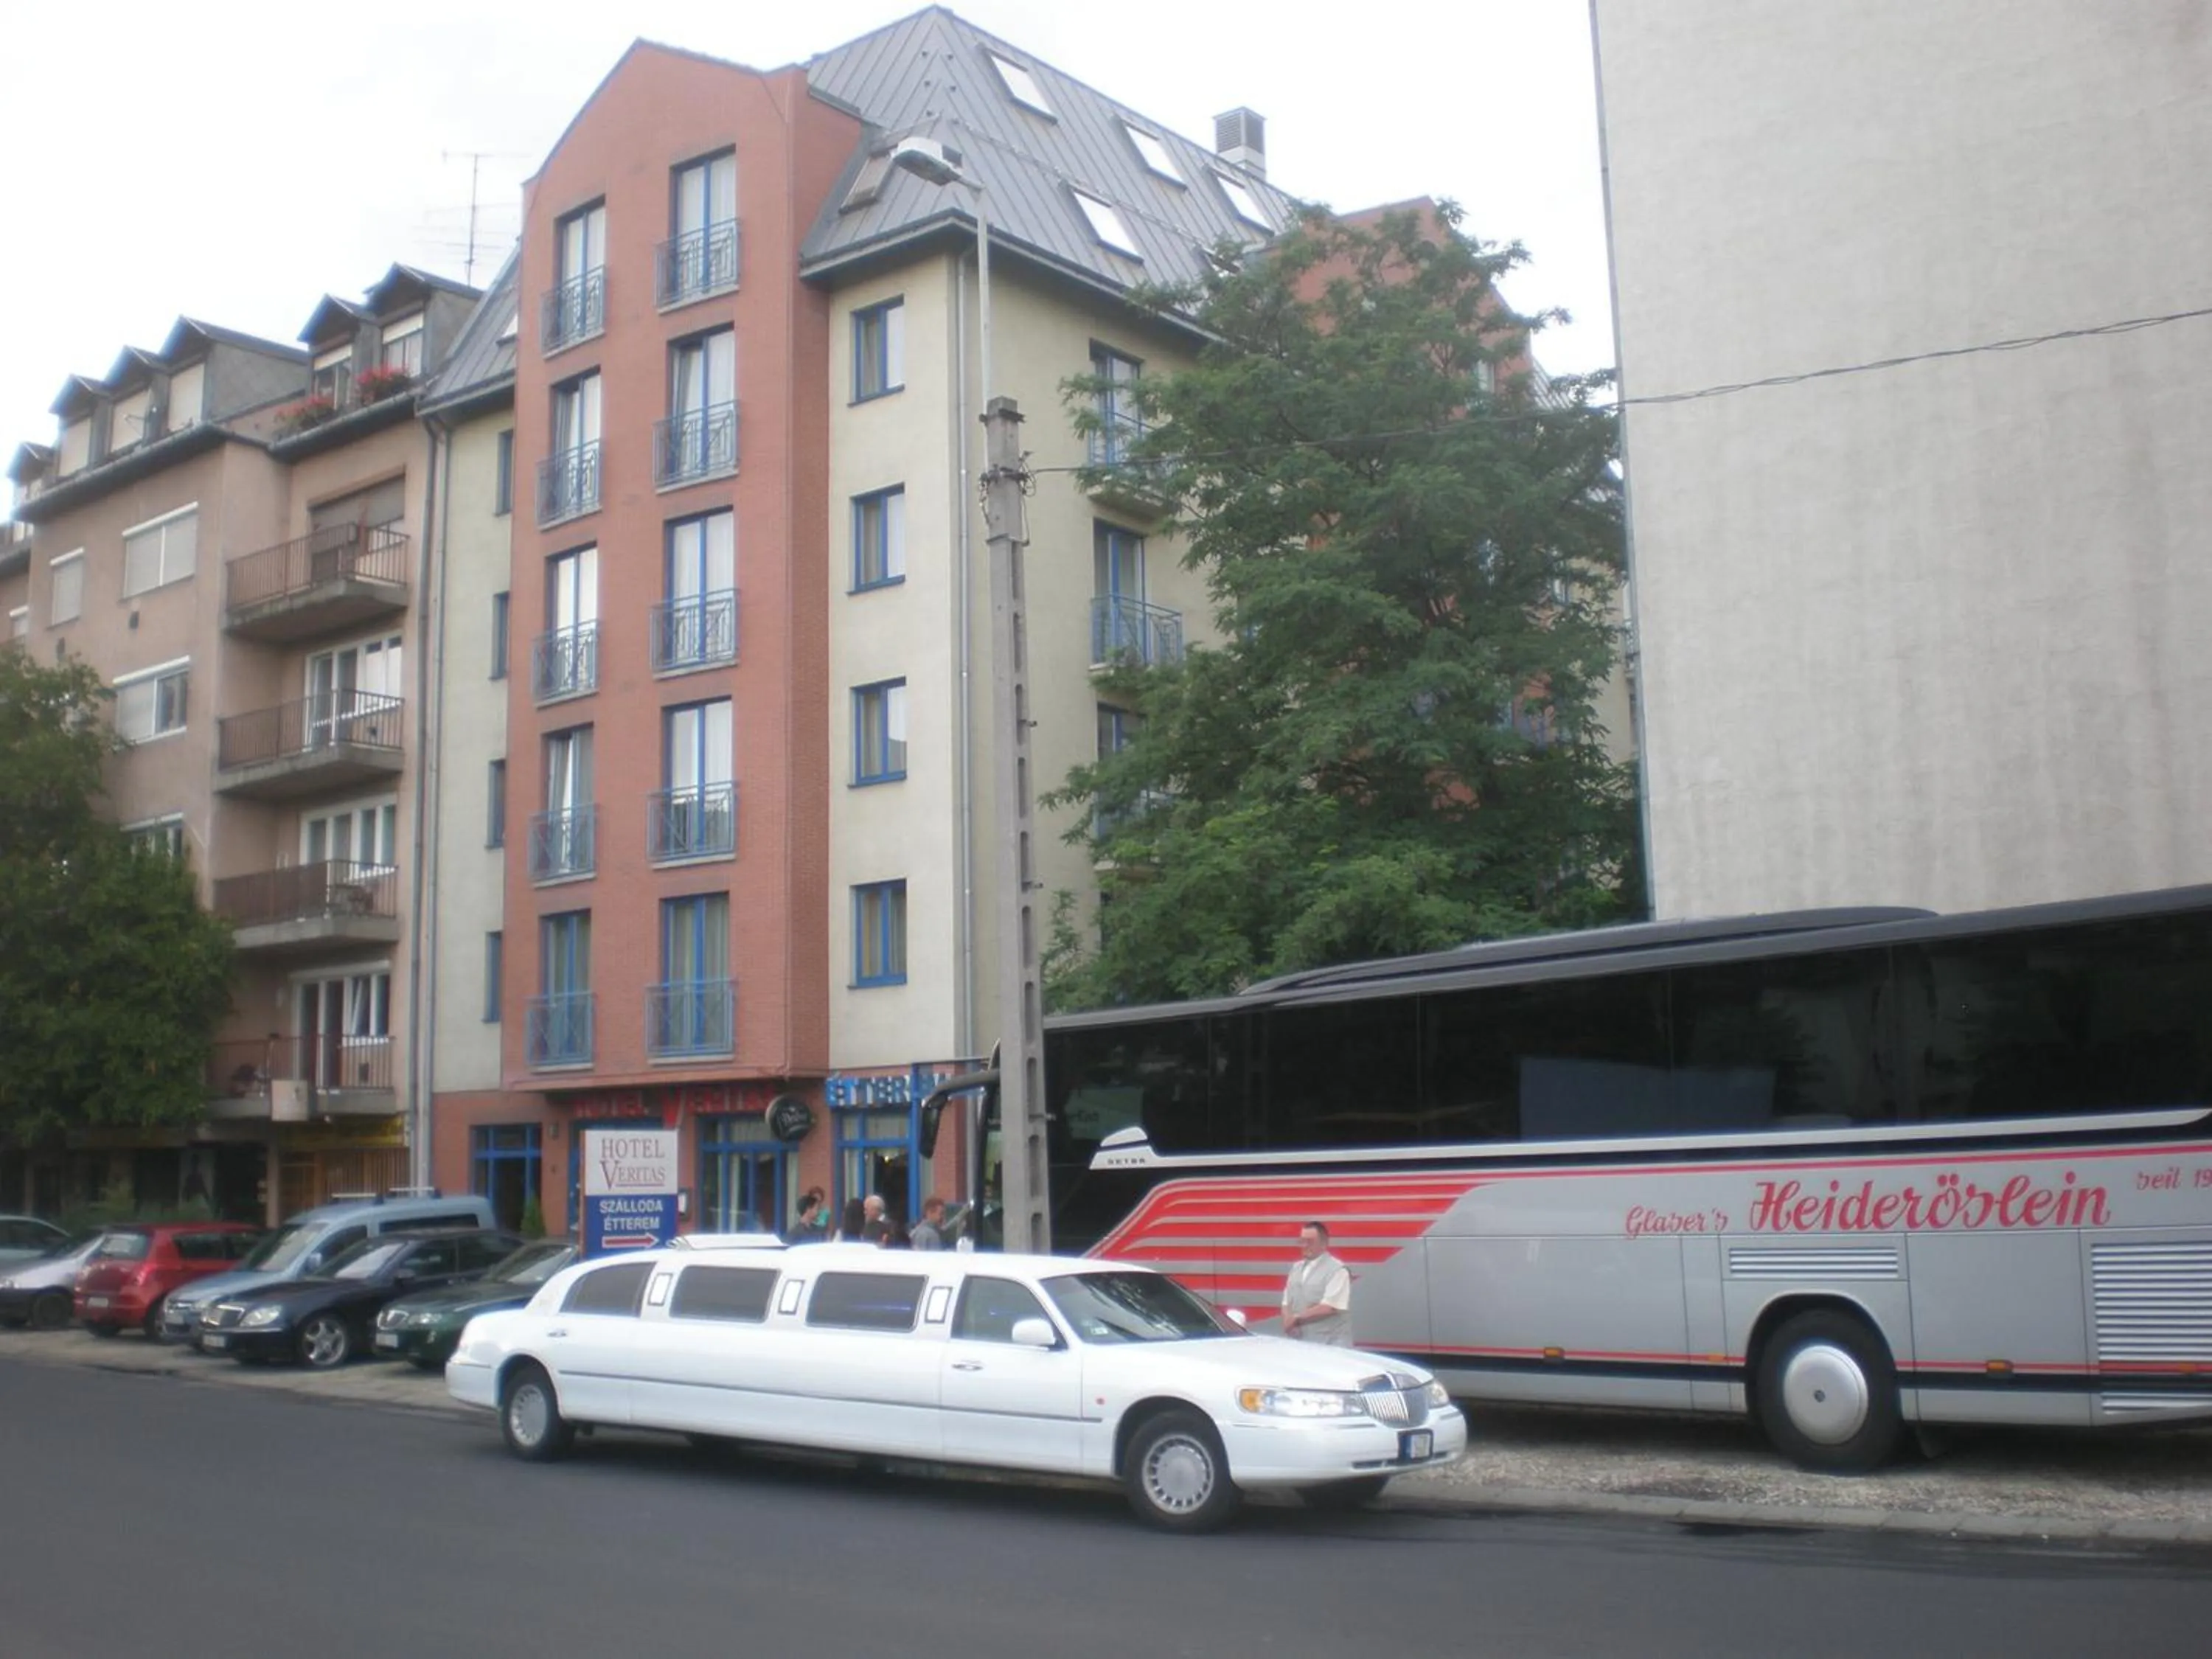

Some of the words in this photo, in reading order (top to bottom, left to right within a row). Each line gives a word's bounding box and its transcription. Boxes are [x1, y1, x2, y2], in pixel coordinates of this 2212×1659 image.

[601, 1138, 665, 1159] HOTEL
[599, 1160, 666, 1191] VERITAS
[599, 1197, 664, 1214] SZÁLLODA
[1749, 1171, 2112, 1231] Heideröslein
[603, 1214, 661, 1231] ÉTTEREM
